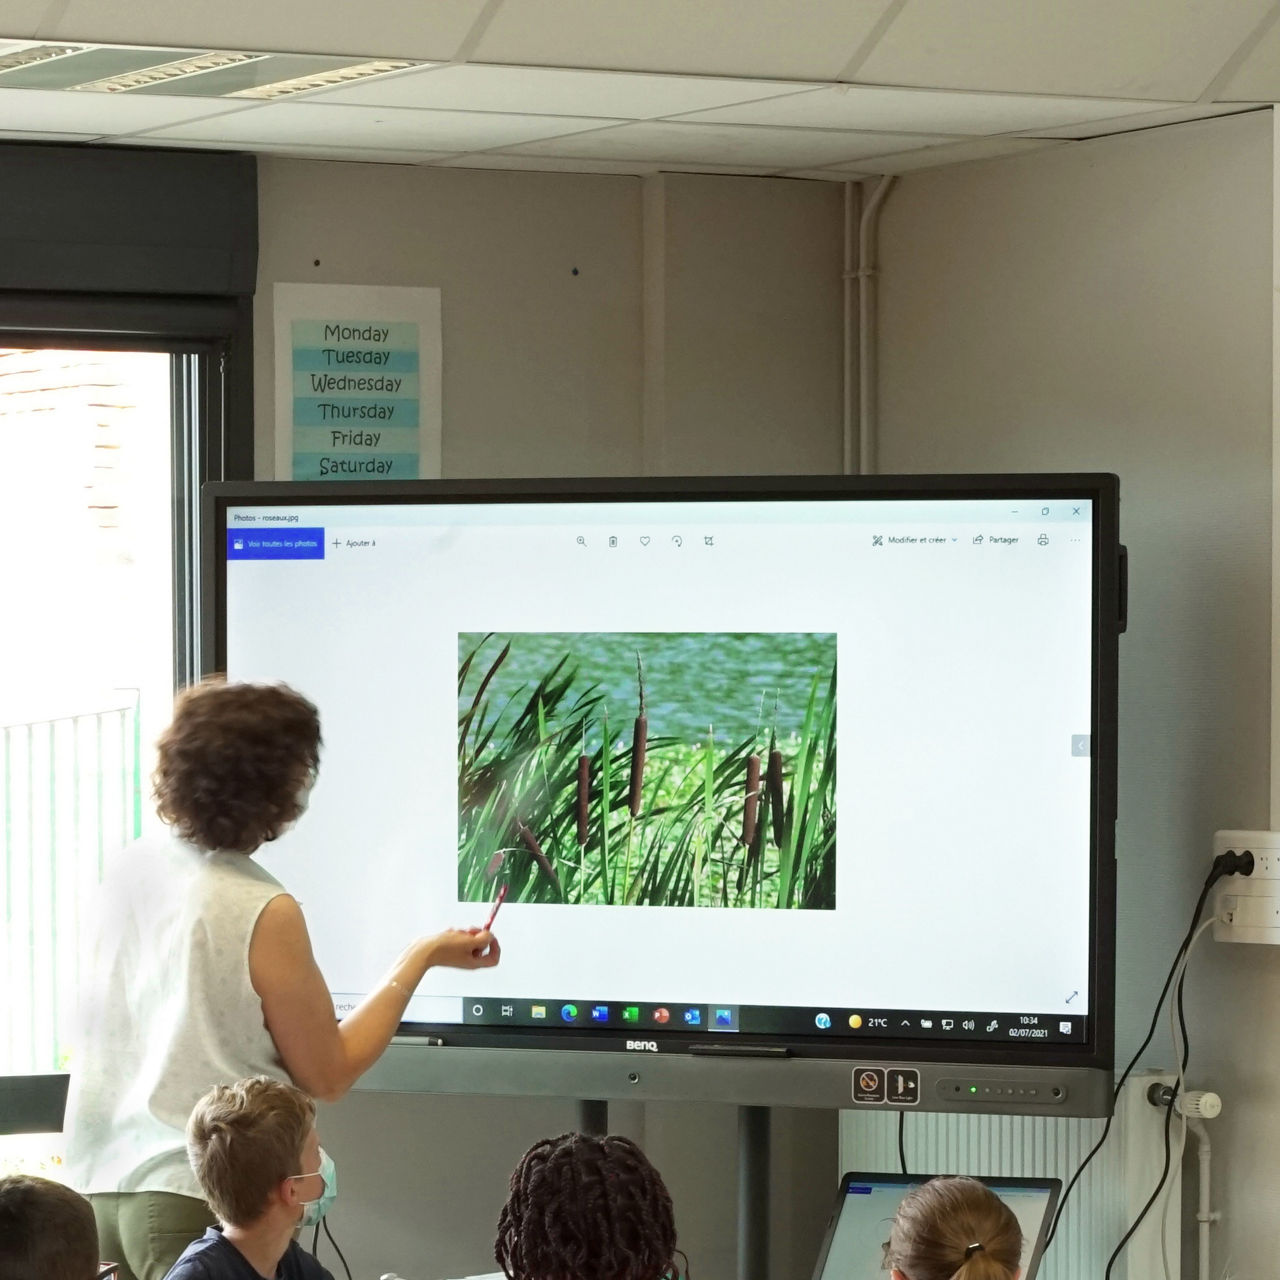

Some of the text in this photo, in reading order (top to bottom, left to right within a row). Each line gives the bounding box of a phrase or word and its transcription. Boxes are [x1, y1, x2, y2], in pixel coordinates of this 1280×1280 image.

[323, 324, 389, 342] Monday
[322, 349, 390, 365] Tuesday
[310, 374, 402, 393] Wednesday
[317, 404, 394, 420] Thursday
[331, 430, 381, 447] Friday
[320, 457, 393, 476] Saturday
[234, 514, 256, 522] Photos
[262, 514, 299, 523] roseaux.jpg
[247, 540, 261, 548] Voir
[262, 540, 282, 548] toutes
[294, 540, 318, 549] photos
[345, 539, 370, 548] Ajouter
[888, 536, 947, 544] Modifier et créer
[989, 536, 1019, 546] Partager
[1020, 1016, 1038, 1025] 10:34
[1009, 1028, 1048, 1038] 02/07/2021
